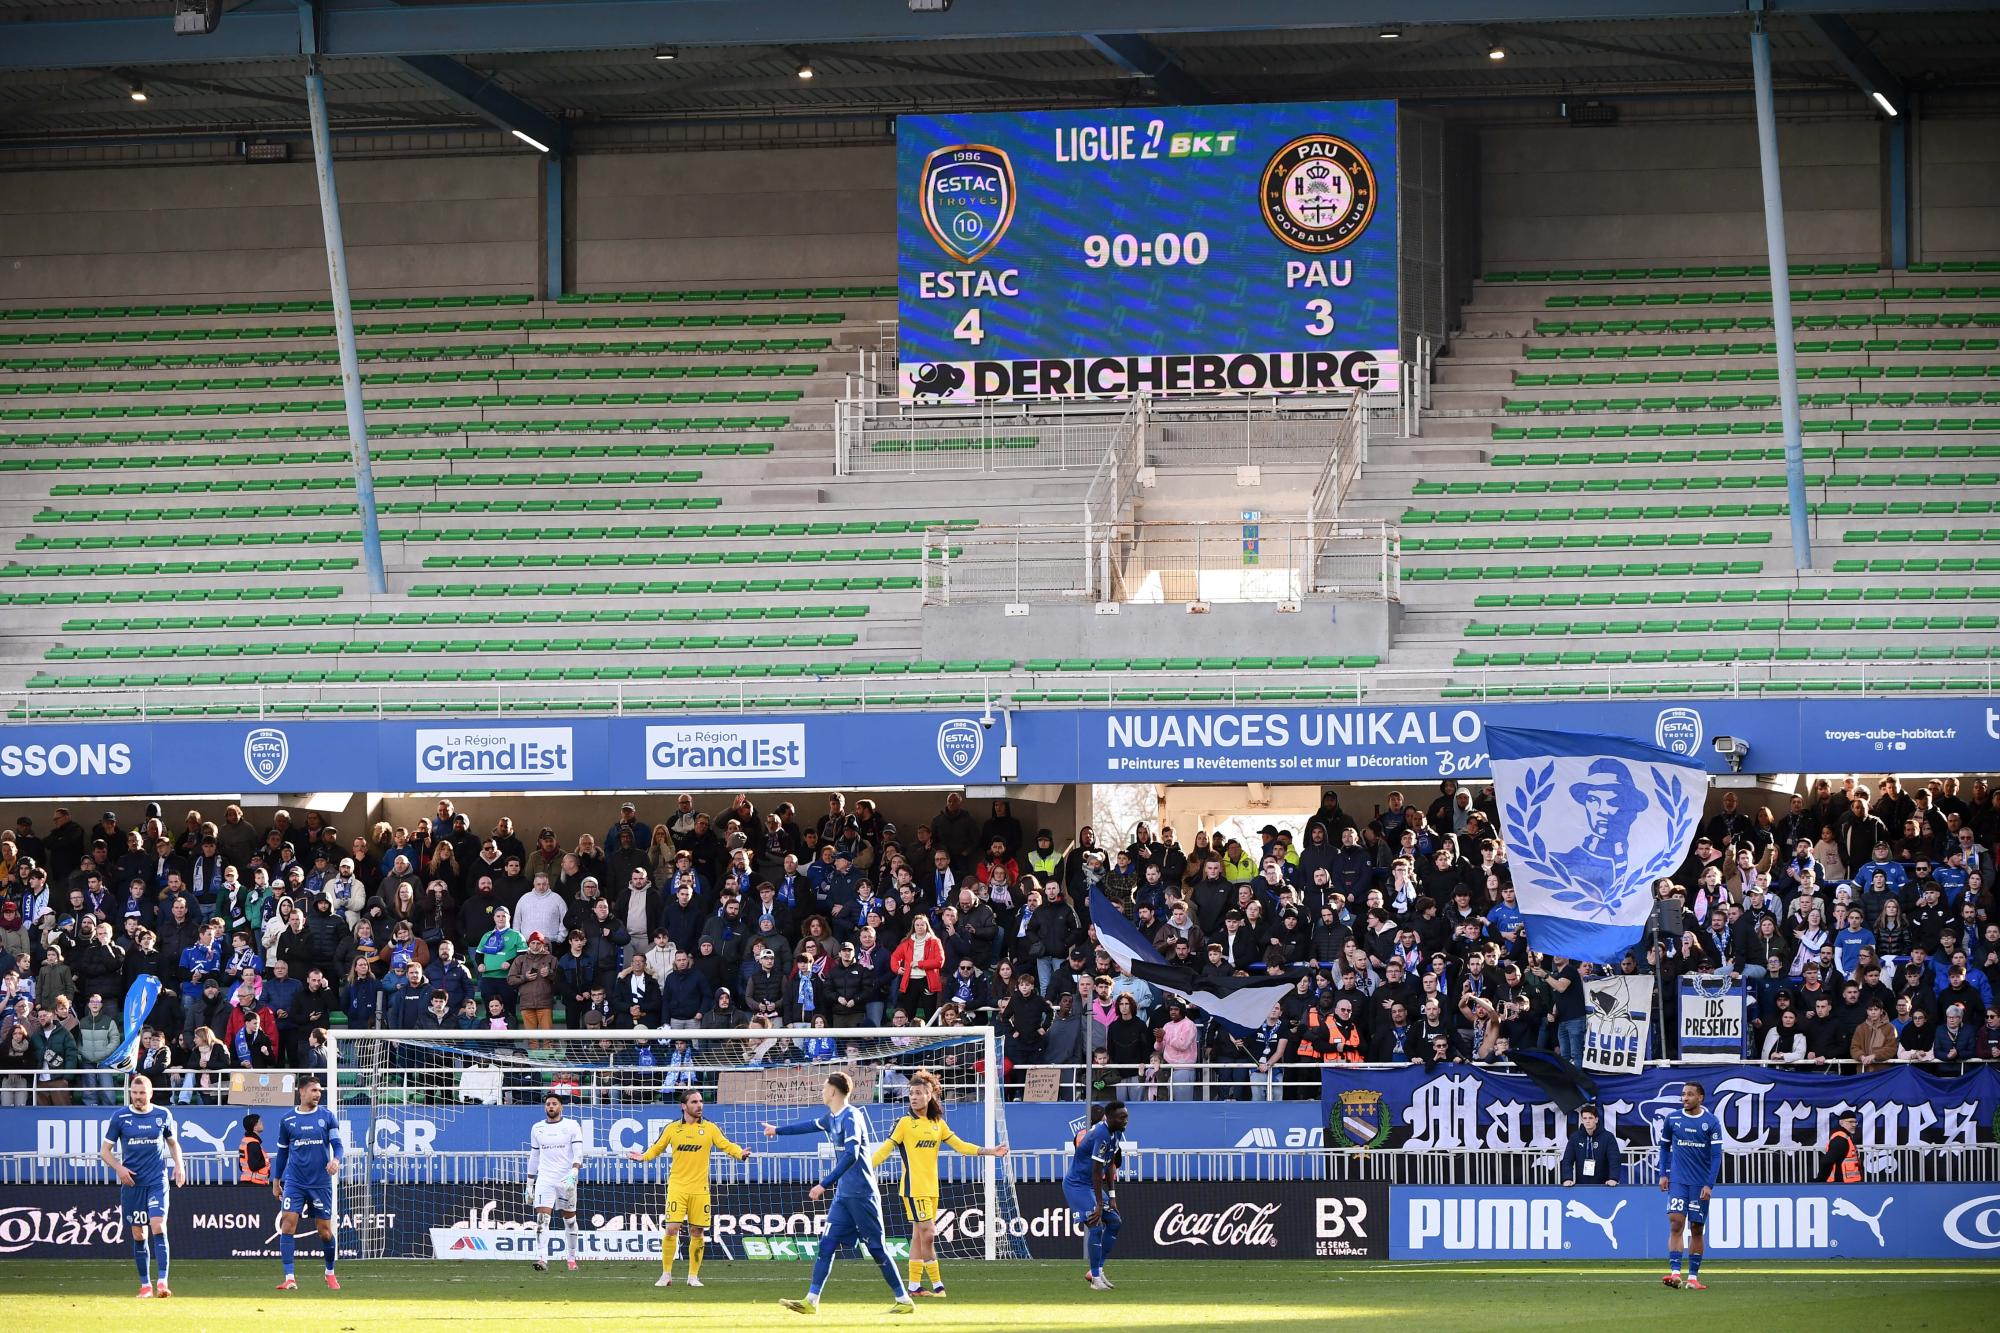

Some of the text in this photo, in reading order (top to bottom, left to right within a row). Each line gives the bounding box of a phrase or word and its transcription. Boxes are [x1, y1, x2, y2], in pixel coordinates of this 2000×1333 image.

[1056, 120, 1236, 162] LIGUE 2 BKT
[954, 152, 981, 162] 1986
[1297, 143, 1338, 159] PAU
[936, 176, 998, 193] ESTAC
[938, 197, 998, 206] TROYES
[958, 219, 978, 233] 10
[1273, 203, 1365, 242] FOOTBALL CLUB
[1084, 232, 1209, 268] 90:00
[1286, 260, 1352, 288] PAU
[920, 269, 1019, 299] ESTAC
[953, 308, 985, 345] 4
[1304, 298, 1335, 336] 3
[974, 351, 1380, 401] DERICHEBOURG
[1107, 710, 1481, 748] NUANCES UNIKALO
[1664, 722, 1694, 732] ESTAC
[1825, 728, 1956, 742] troyes-aube-habitat.fr
[446, 735, 507, 747] La Région
[677, 731, 738, 743] La Région
[945, 734, 974, 742] ESTAC
[252, 743, 281, 752] ESTAC
[422, 743, 567, 771] Grand Est
[652, 739, 800, 768] Grand Est
[0, 743, 131, 776] SSONS
[1121, 754, 1428, 771] Peintures Revêtements sol et mur Décoration
[1705, 1000, 1723, 1018] IDS
[1685, 1018, 1739, 1037] PRESENTS
[1588, 1031, 1639, 1052] EUNE
[1586, 1047, 1637, 1067] ARDE
[1402, 1073, 1633, 1171] Magc
[677, 1144, 702, 1153] HOLY
[284, 1197, 291, 1210] 6
[1670, 1198, 1684, 1211] 23
[134, 1211, 147, 1224] 20
[193, 1214, 260, 1229] MAISON
[1154, 1203, 1281, 1245] Coca-Cola
[1316, 1197, 1368, 1238] BR
[1409, 1199, 1562, 1249] PUMA
[496, 1233, 663, 1256] ampitude
[743, 1241, 817, 1256] BKT
